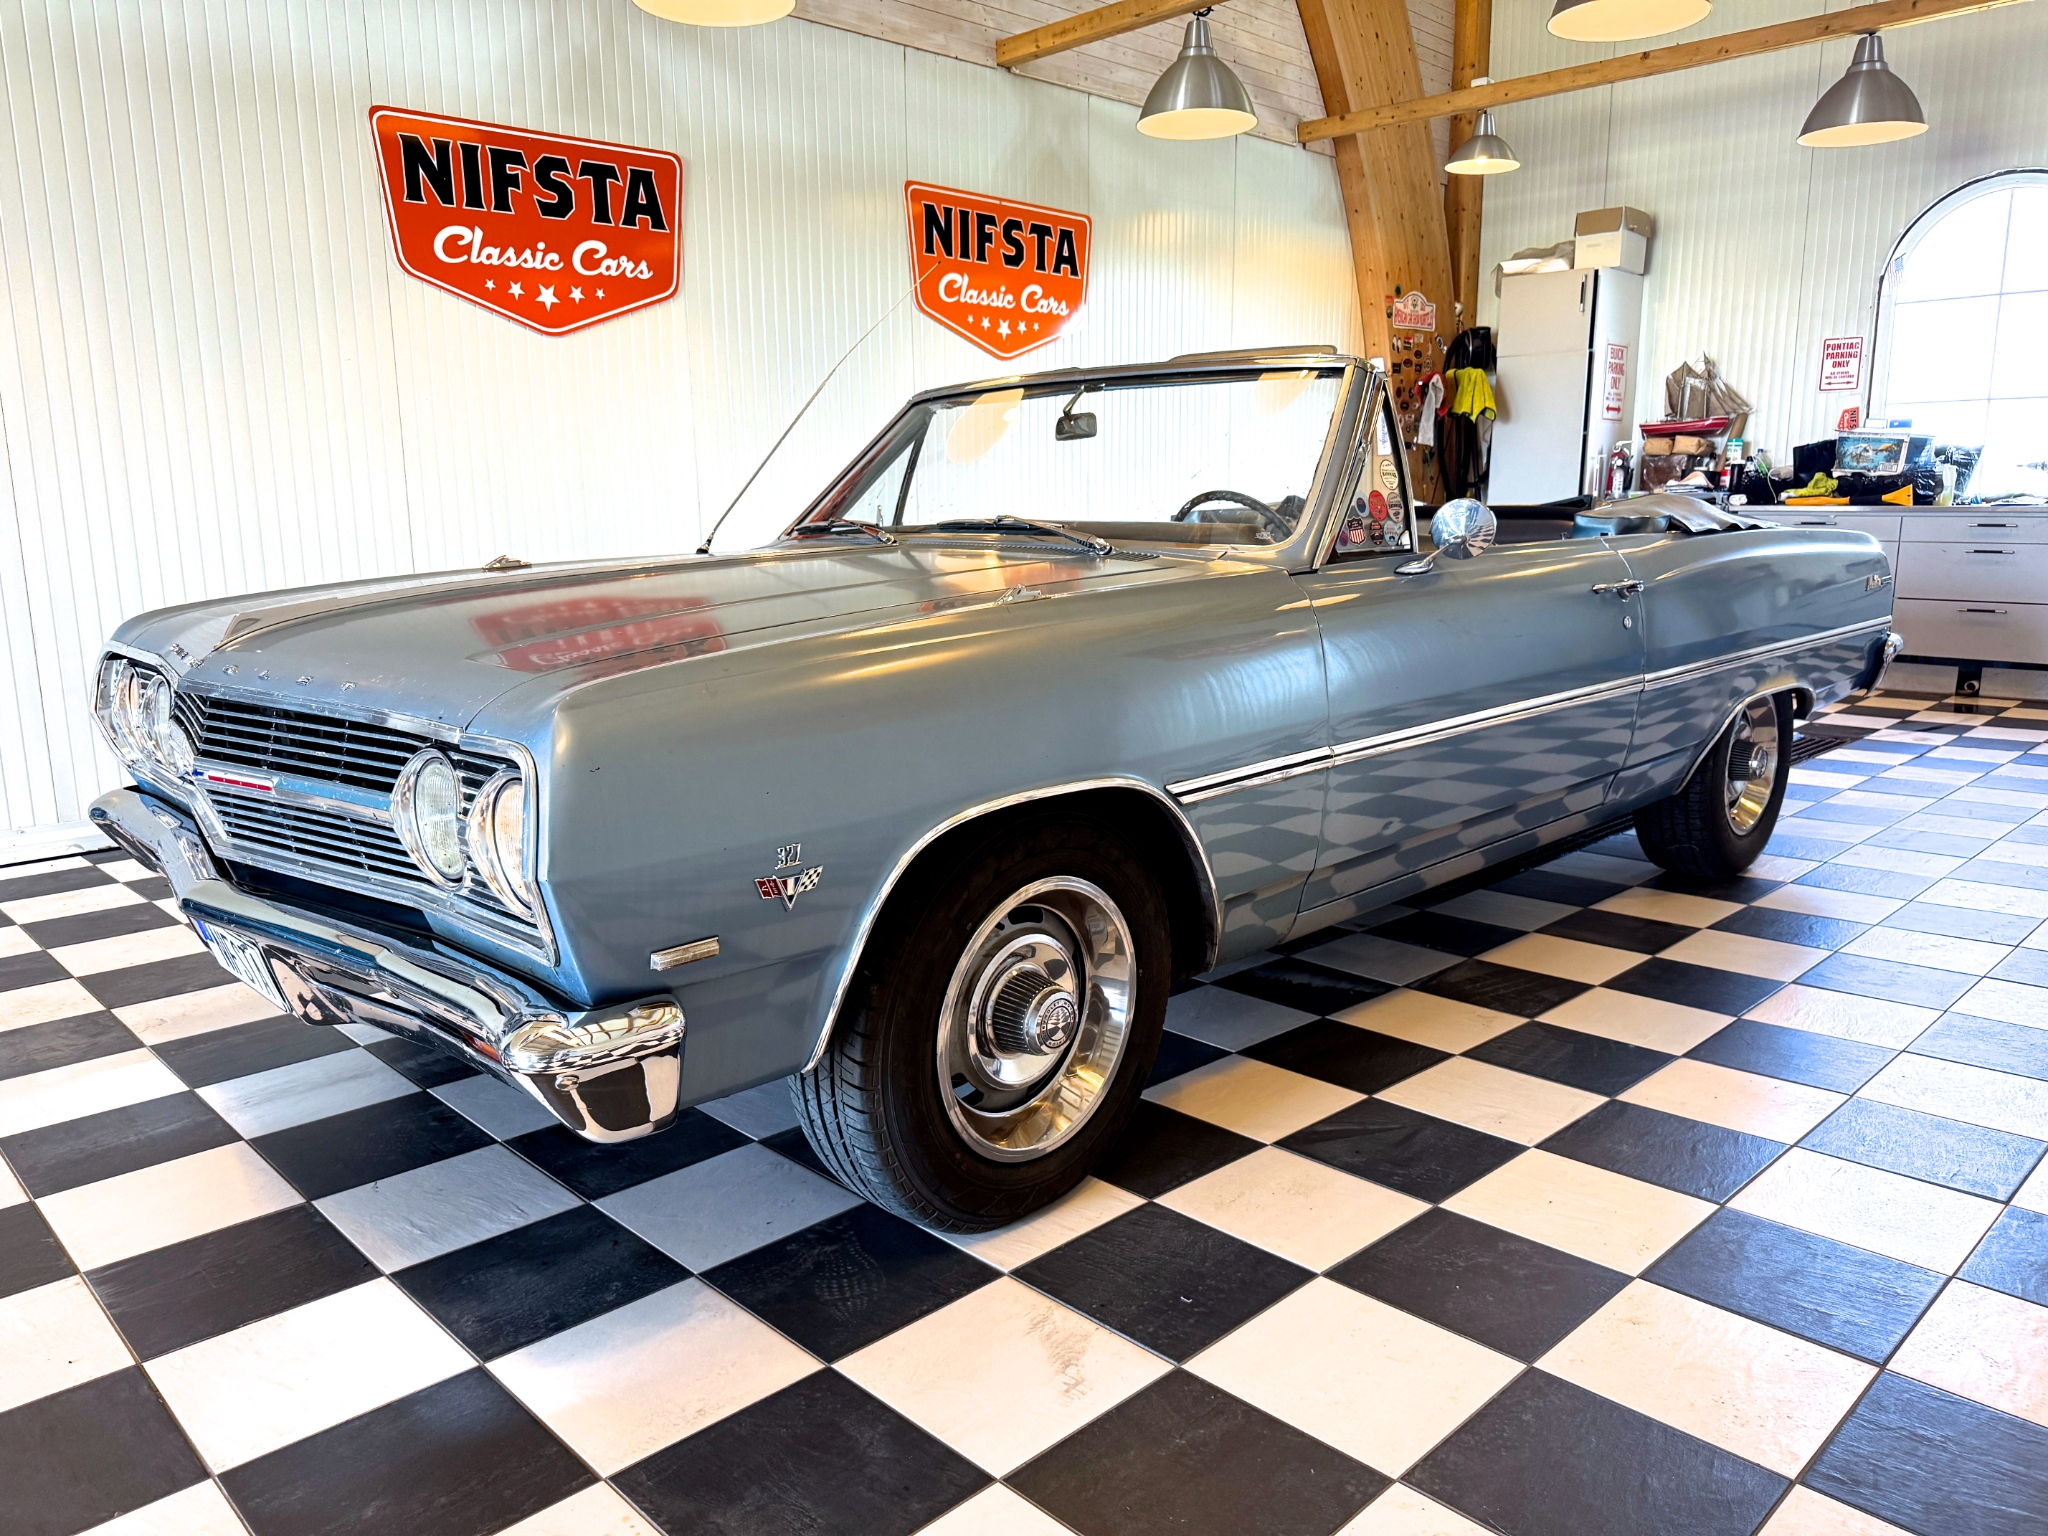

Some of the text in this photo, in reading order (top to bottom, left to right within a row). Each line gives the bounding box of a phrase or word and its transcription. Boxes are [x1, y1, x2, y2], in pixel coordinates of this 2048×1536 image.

[397, 132, 670, 233] NIFSTA
[433, 225, 653, 280] Classic Cars
[921, 201, 1081, 279] NIFSTA
[938, 273, 1069, 316] Classic Cars
[1826, 342, 1860, 351] PONTIAC
[1826, 351, 1858, 360] PARKING
[1832, 360, 1850, 368] ONLY
[775, 843, 802, 869] 327
